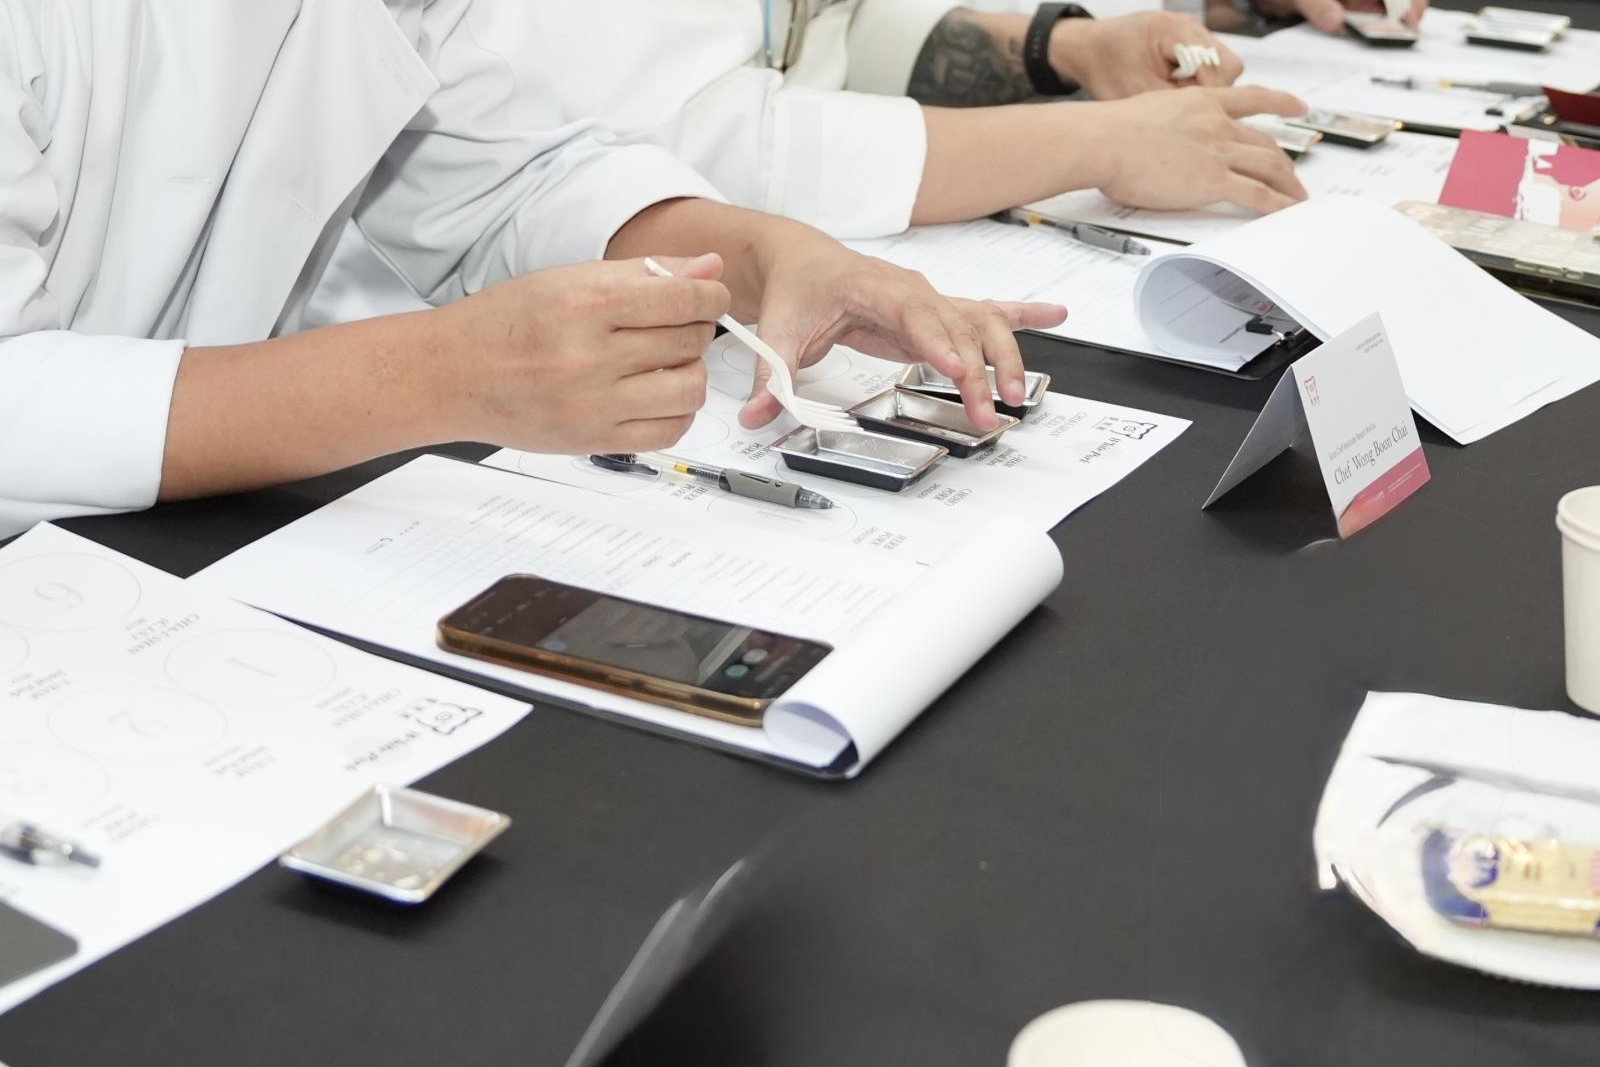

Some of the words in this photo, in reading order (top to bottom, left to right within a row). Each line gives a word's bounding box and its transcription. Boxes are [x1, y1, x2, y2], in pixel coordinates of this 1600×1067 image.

[1080, 449, 1103, 464] Pork
[1334, 460, 1352, 485] Chef
[1352, 449, 1376, 470] Wong
[1373, 438, 1393, 457] Boon
[1391, 421, 1409, 443] Chai
[935, 489, 956, 501] PORK
[871, 531, 893, 545] PORK
[881, 535, 906, 549] HERB
[34, 582, 84, 608] 6
[129, 614, 199, 654] CHIA-I-SHAN
[224, 656, 276, 678] 1
[107, 710, 168, 736] 2
[380, 732, 418, 752] White
[345, 752, 379, 770] Pork
